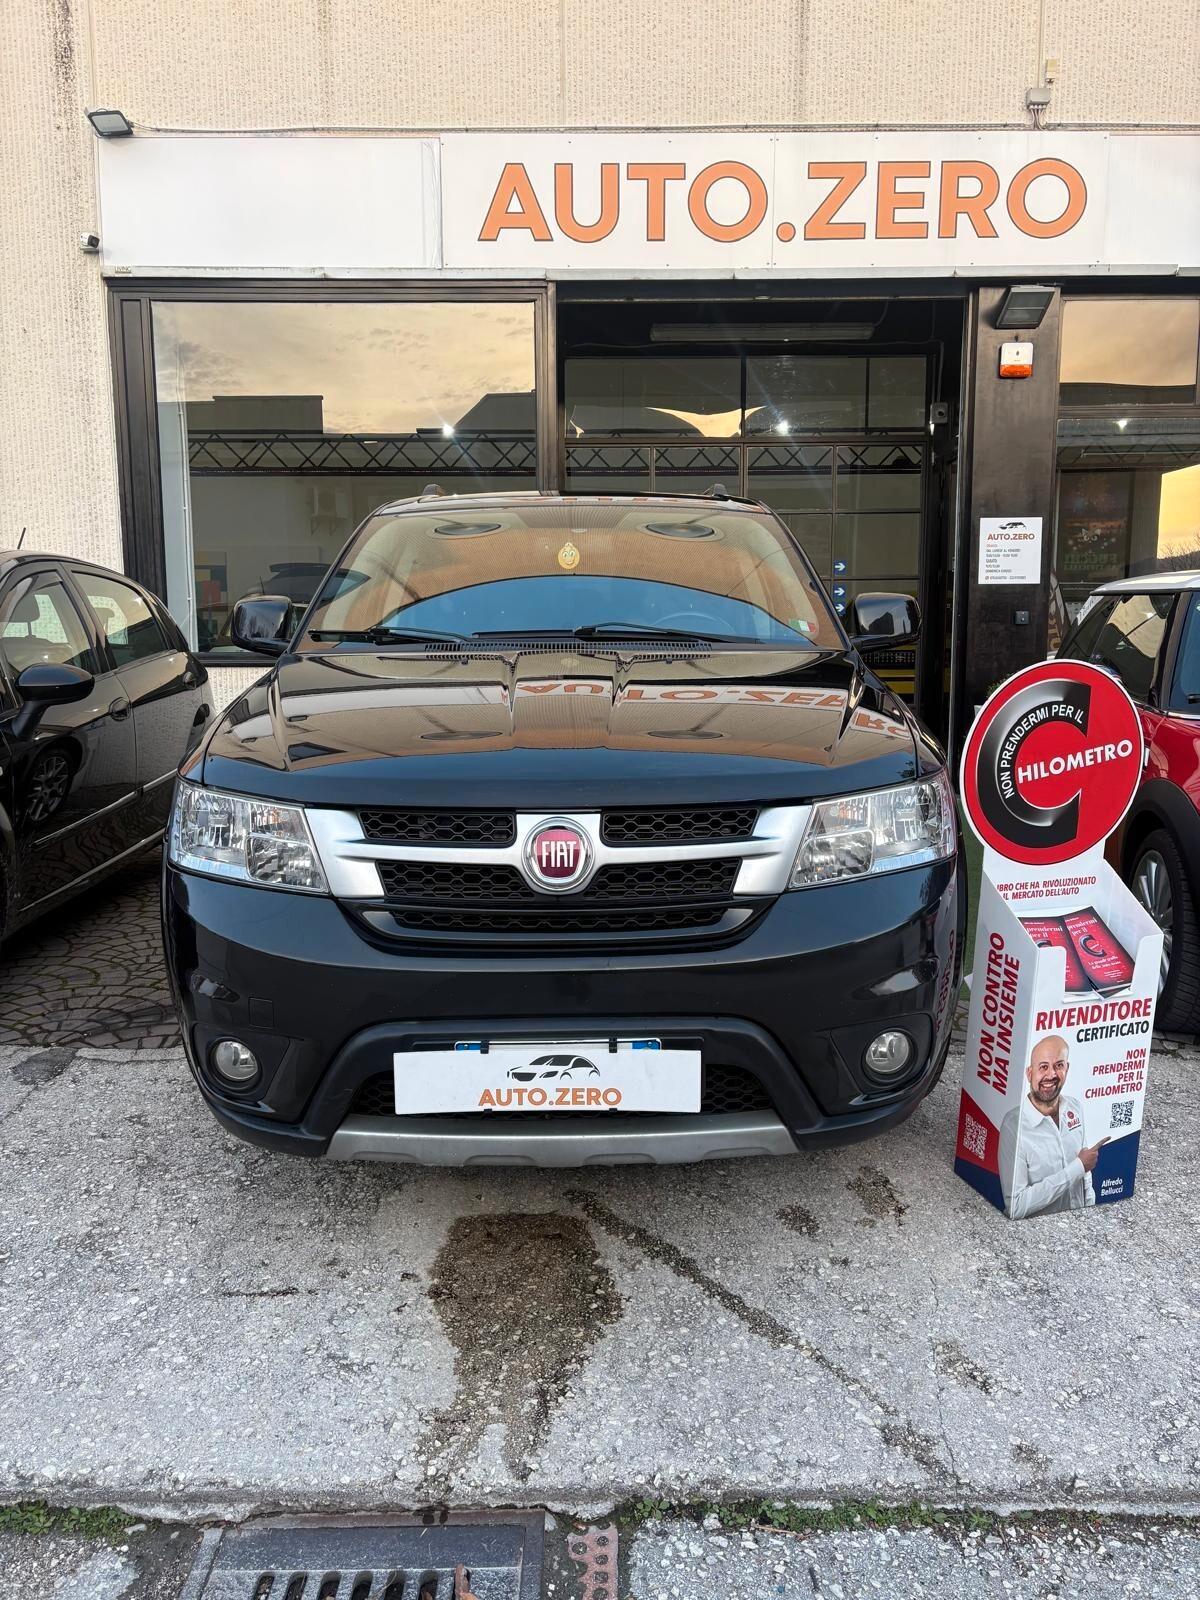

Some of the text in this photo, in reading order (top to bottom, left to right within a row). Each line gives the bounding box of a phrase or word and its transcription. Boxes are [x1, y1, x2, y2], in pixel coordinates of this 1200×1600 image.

[477, 157, 1088, 243] AUTO.ZERO
[987, 533, 1035, 541] AUTO.ZERO
[1000, 704, 1084, 799] NON PRENDERMI PER IL
[541, 840, 577, 868] FIAT
[1014, 882, 1029, 891] CHE
[1029, 880, 1040, 889] HA
[1042, 876, 1097, 888] RIVOLUZIONATO
[1011, 890, 1044, 900] MERCATO
[1045, 887, 1080, 897] DELL'AUTO
[977, 933, 1004, 1085] NON CONTRO
[1035, 998, 1152, 1031] RIVENDITORE
[992, 954, 1020, 1096] MA INSIEME
[1076, 1020, 1150, 1043] CERTIFICATO
[1126, 1048, 1146, 1060] NON
[1092, 1059, 1145, 1076] PRENDERMI
[1117, 1070, 1144, 1083] PER IL
[478, 1087, 622, 1106] AUTO.ZERO
[1085, 1081, 1143, 1099] CHILOMETRO
[1101, 1177, 1123, 1188] Alfredo
[1101, 1185, 1123, 1197] Bellucci
